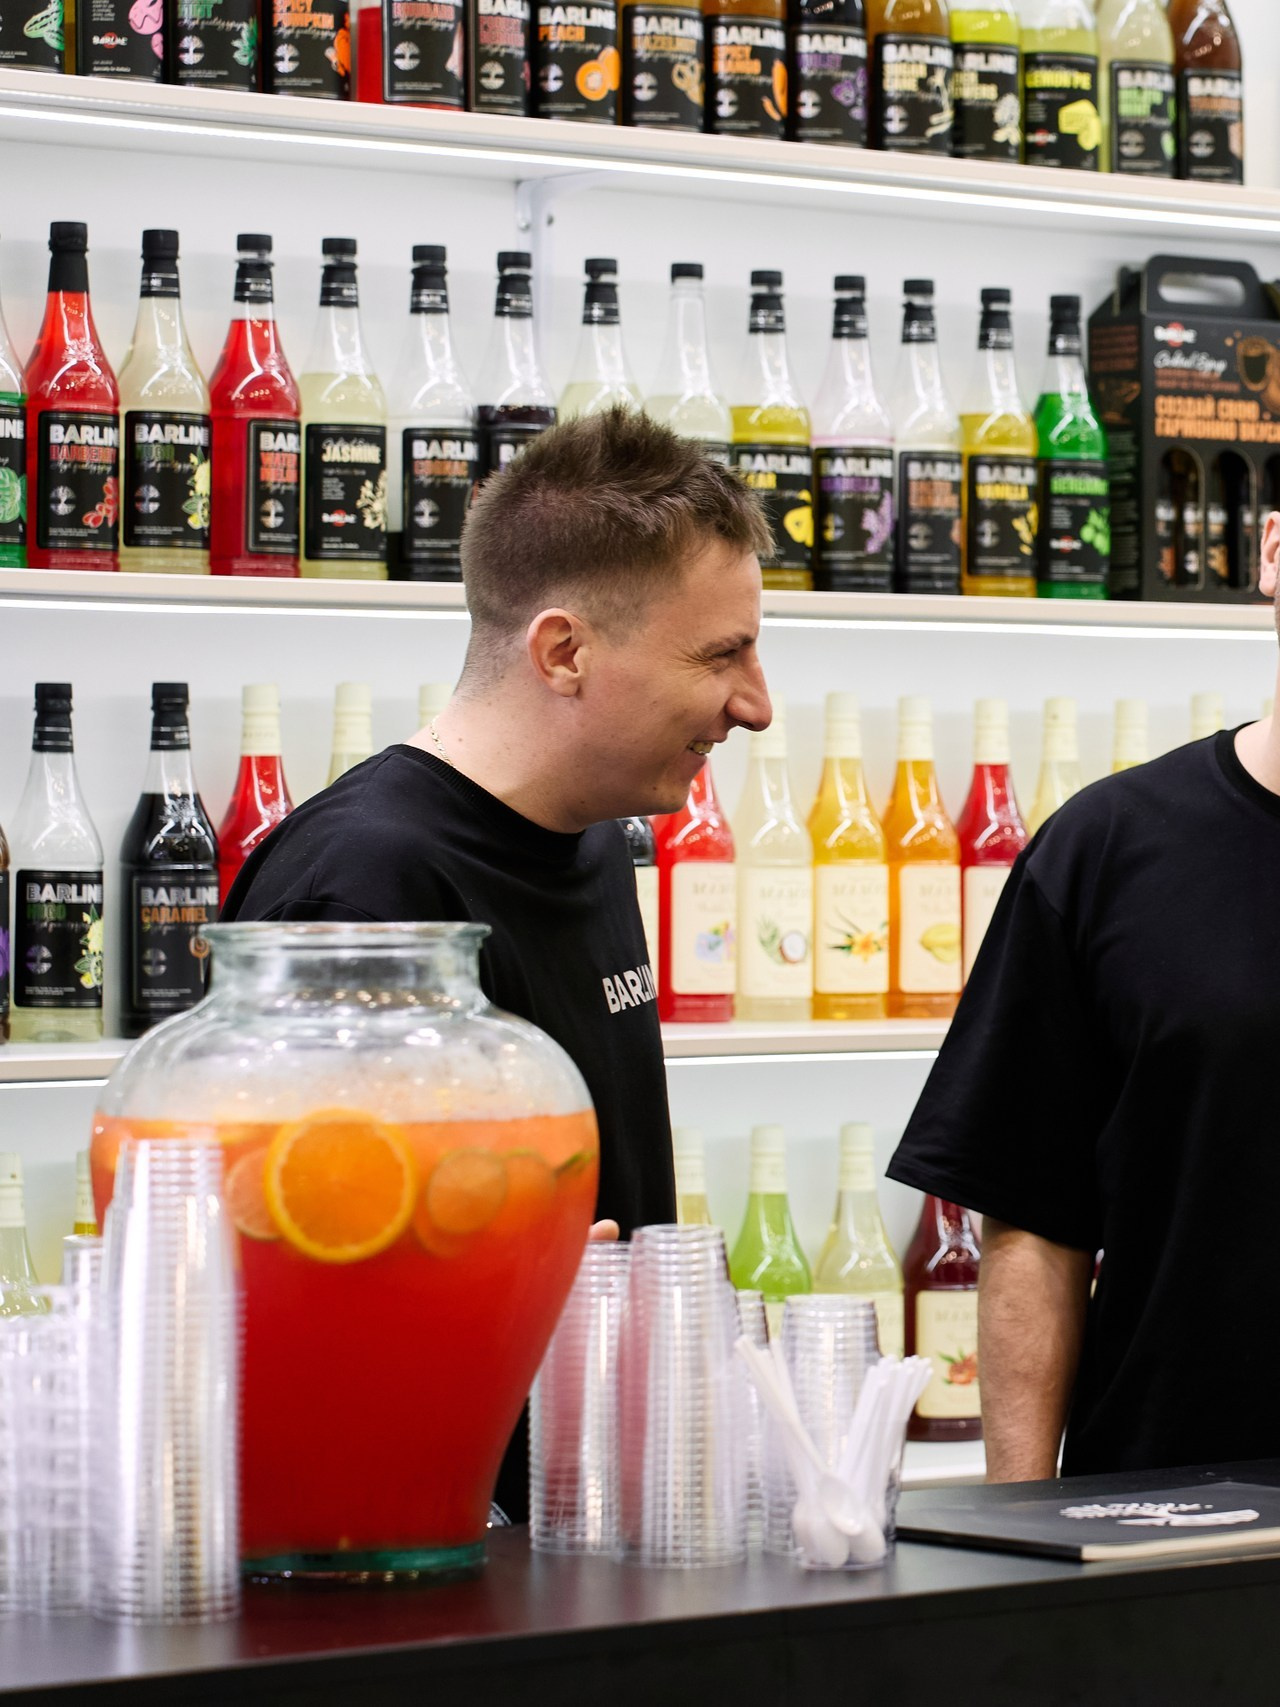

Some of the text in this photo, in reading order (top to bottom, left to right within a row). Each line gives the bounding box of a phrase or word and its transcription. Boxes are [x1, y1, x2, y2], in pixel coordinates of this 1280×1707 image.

[272, 11, 335, 29] PUMPKIN
[538, 25, 586, 42] PEACH
[321, 444, 382, 464] JASMINE
[141, 905, 209, 924] CARAMEL
